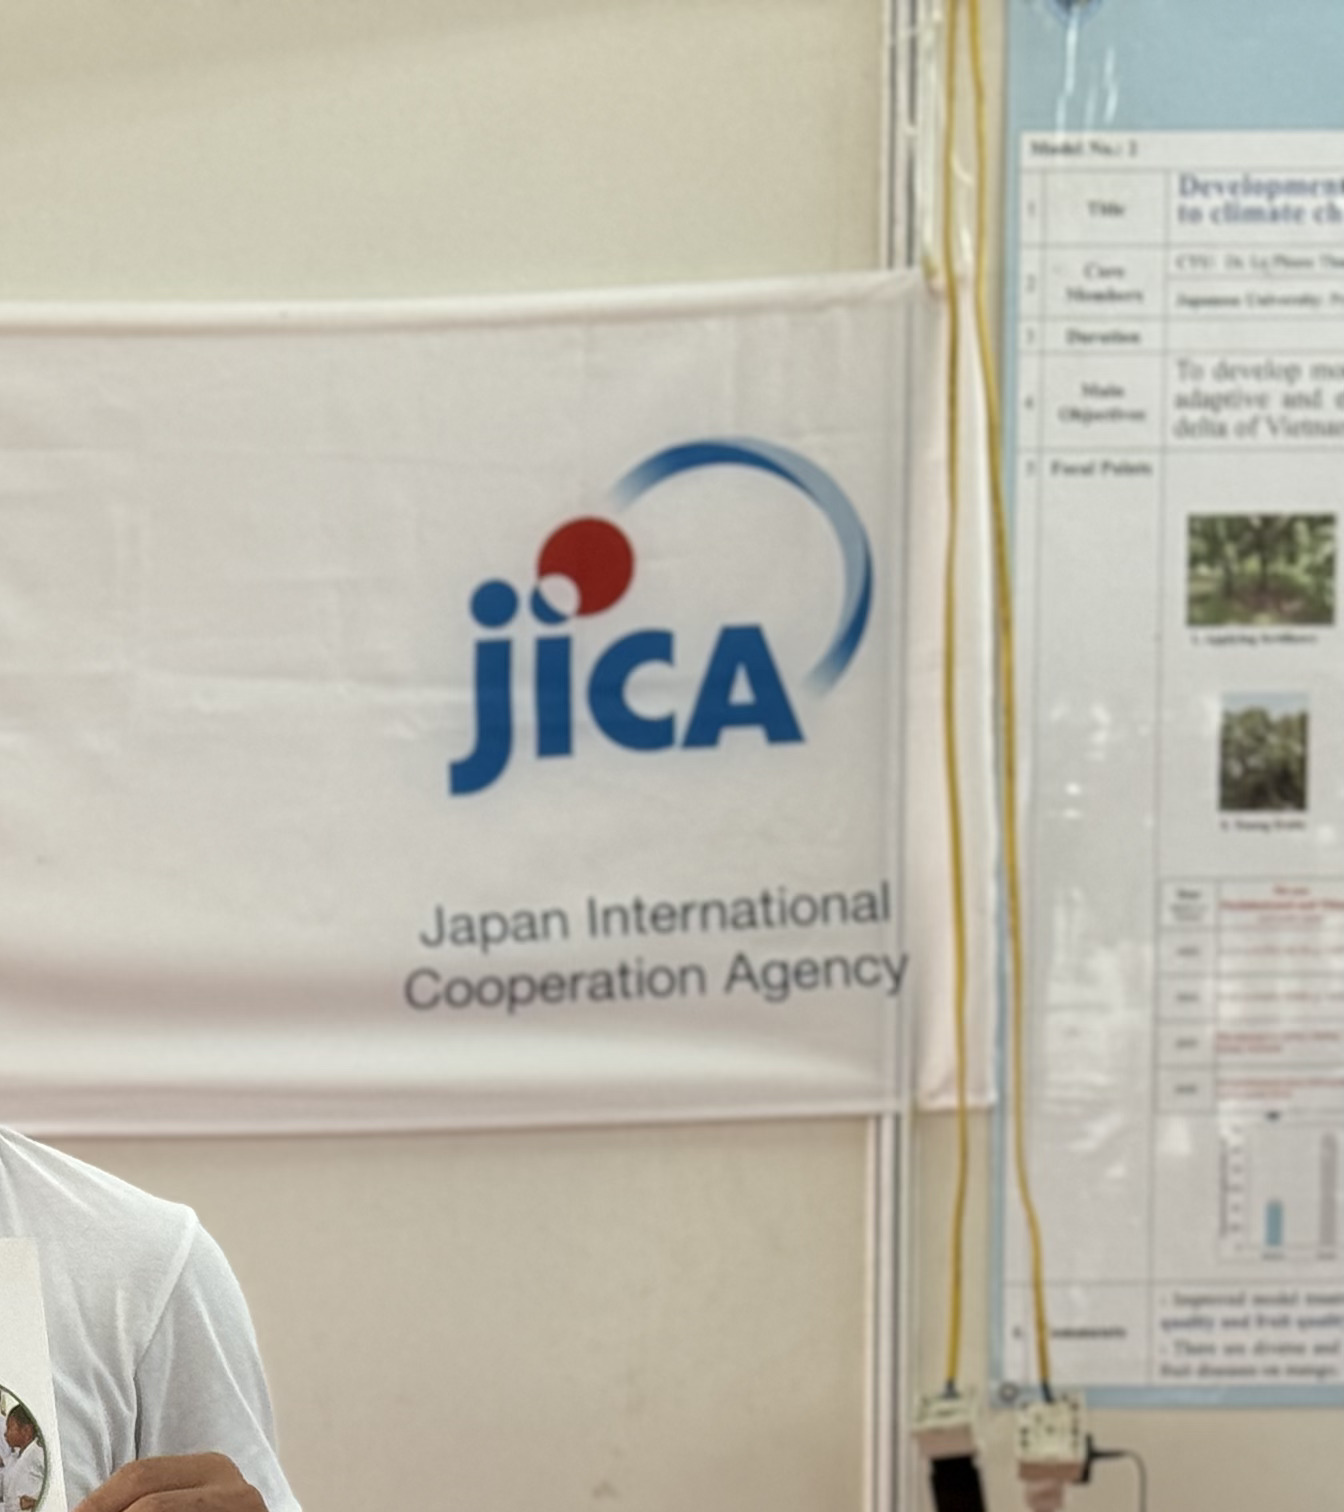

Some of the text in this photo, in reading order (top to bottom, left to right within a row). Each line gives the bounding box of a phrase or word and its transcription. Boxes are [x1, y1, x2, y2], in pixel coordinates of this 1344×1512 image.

[1178, 205, 1203, 225] to
[1211, 203, 1306, 225] climate
[1176, 360, 1205, 381] To
[1211, 360, 1303, 386] develop
[1174, 389, 1323, 413] adaptive and
[1233, 414, 1263, 438] of
[1266, 415, 1344, 438] Vietna
[420, 880, 891, 956] Japan International
[404, 950, 910, 1015] Cooperation Agency
